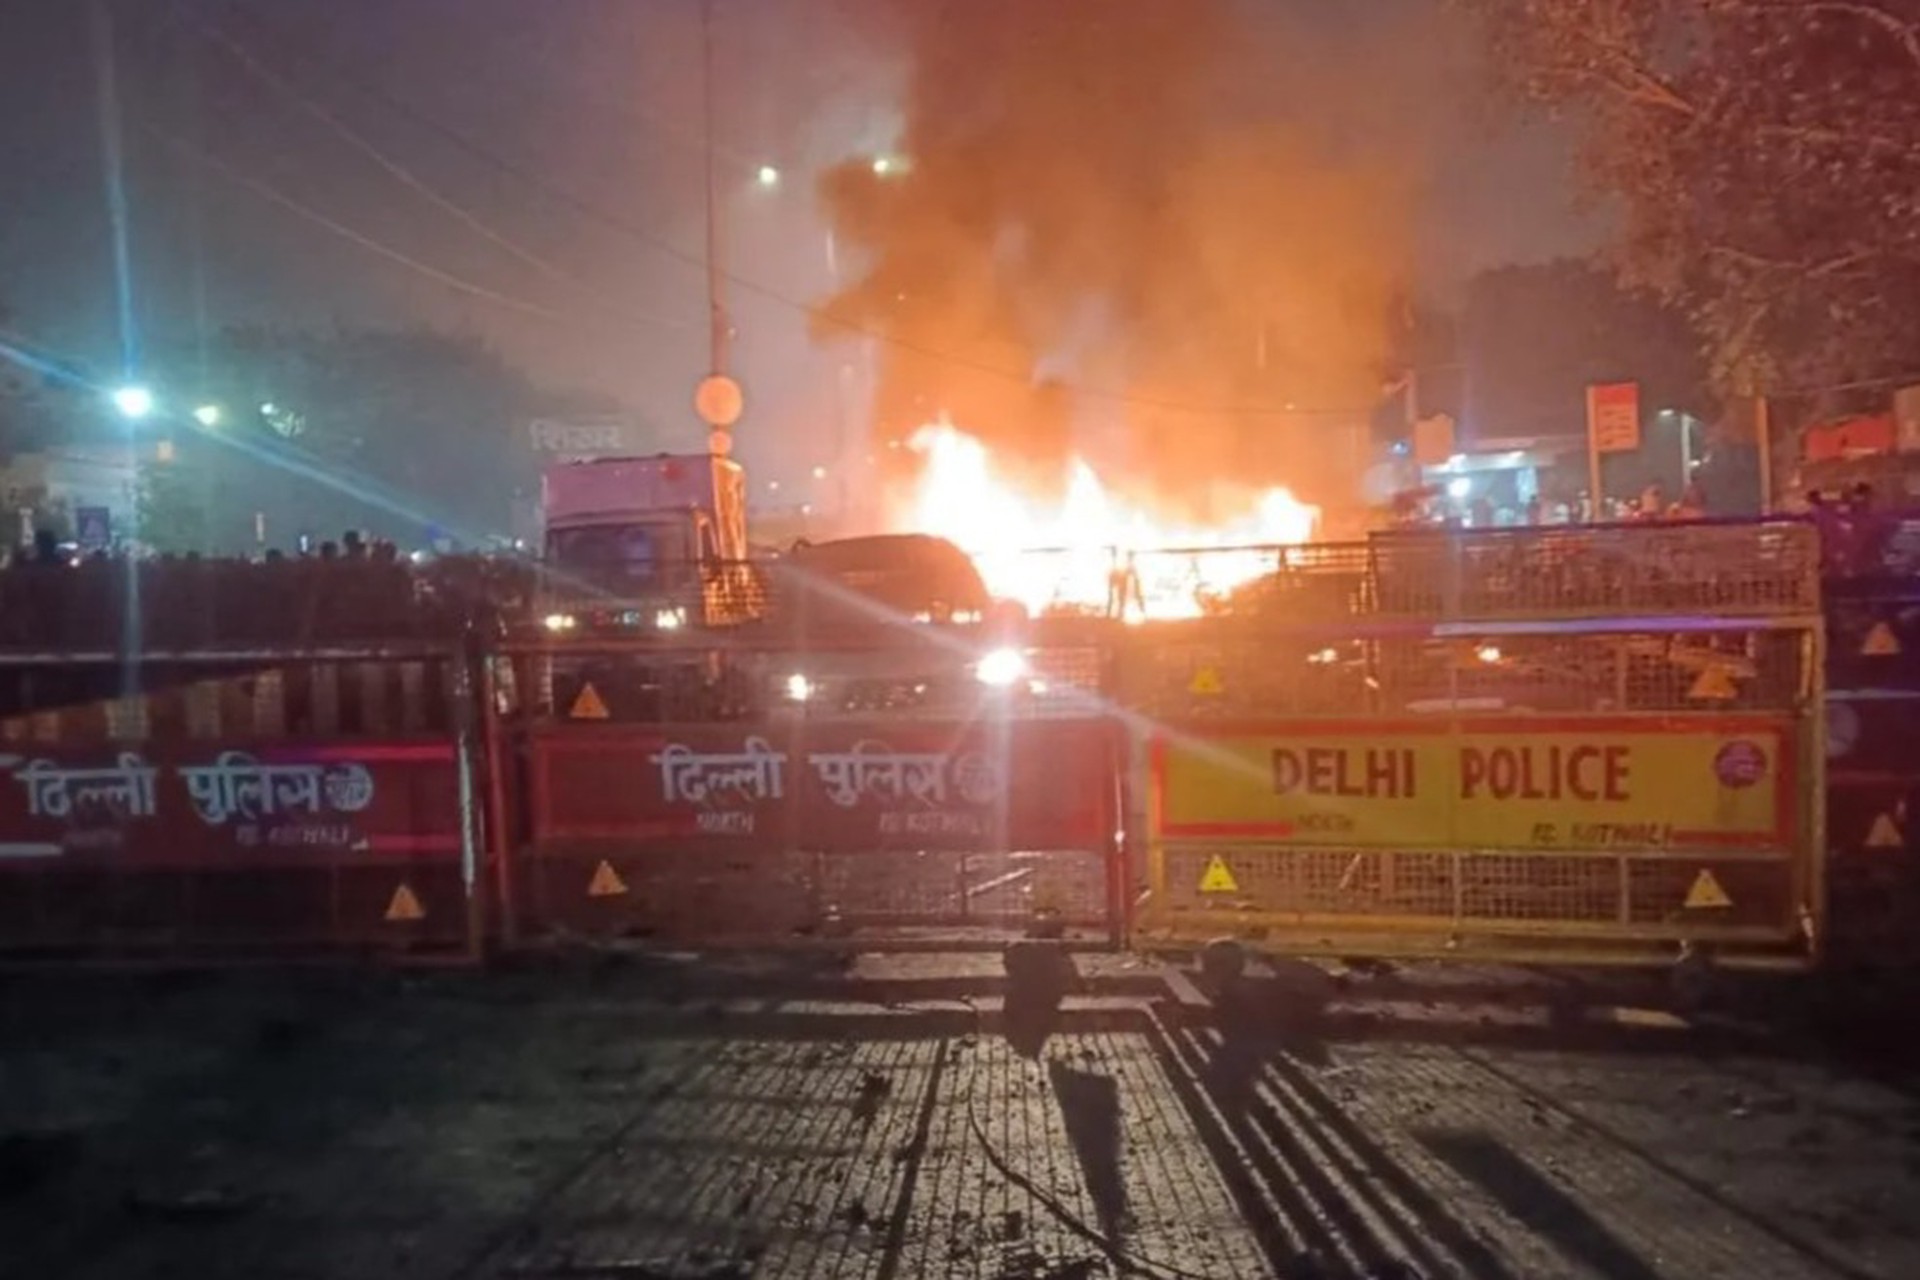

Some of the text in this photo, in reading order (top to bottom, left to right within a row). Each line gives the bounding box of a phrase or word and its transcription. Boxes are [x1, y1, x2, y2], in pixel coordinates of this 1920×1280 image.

[13, 750, 323, 825] दिल्ली पुलिस
[649, 736, 949, 809] दिल्ली पुलिस
[1272, 745, 1631, 802] DELHI POLICE
